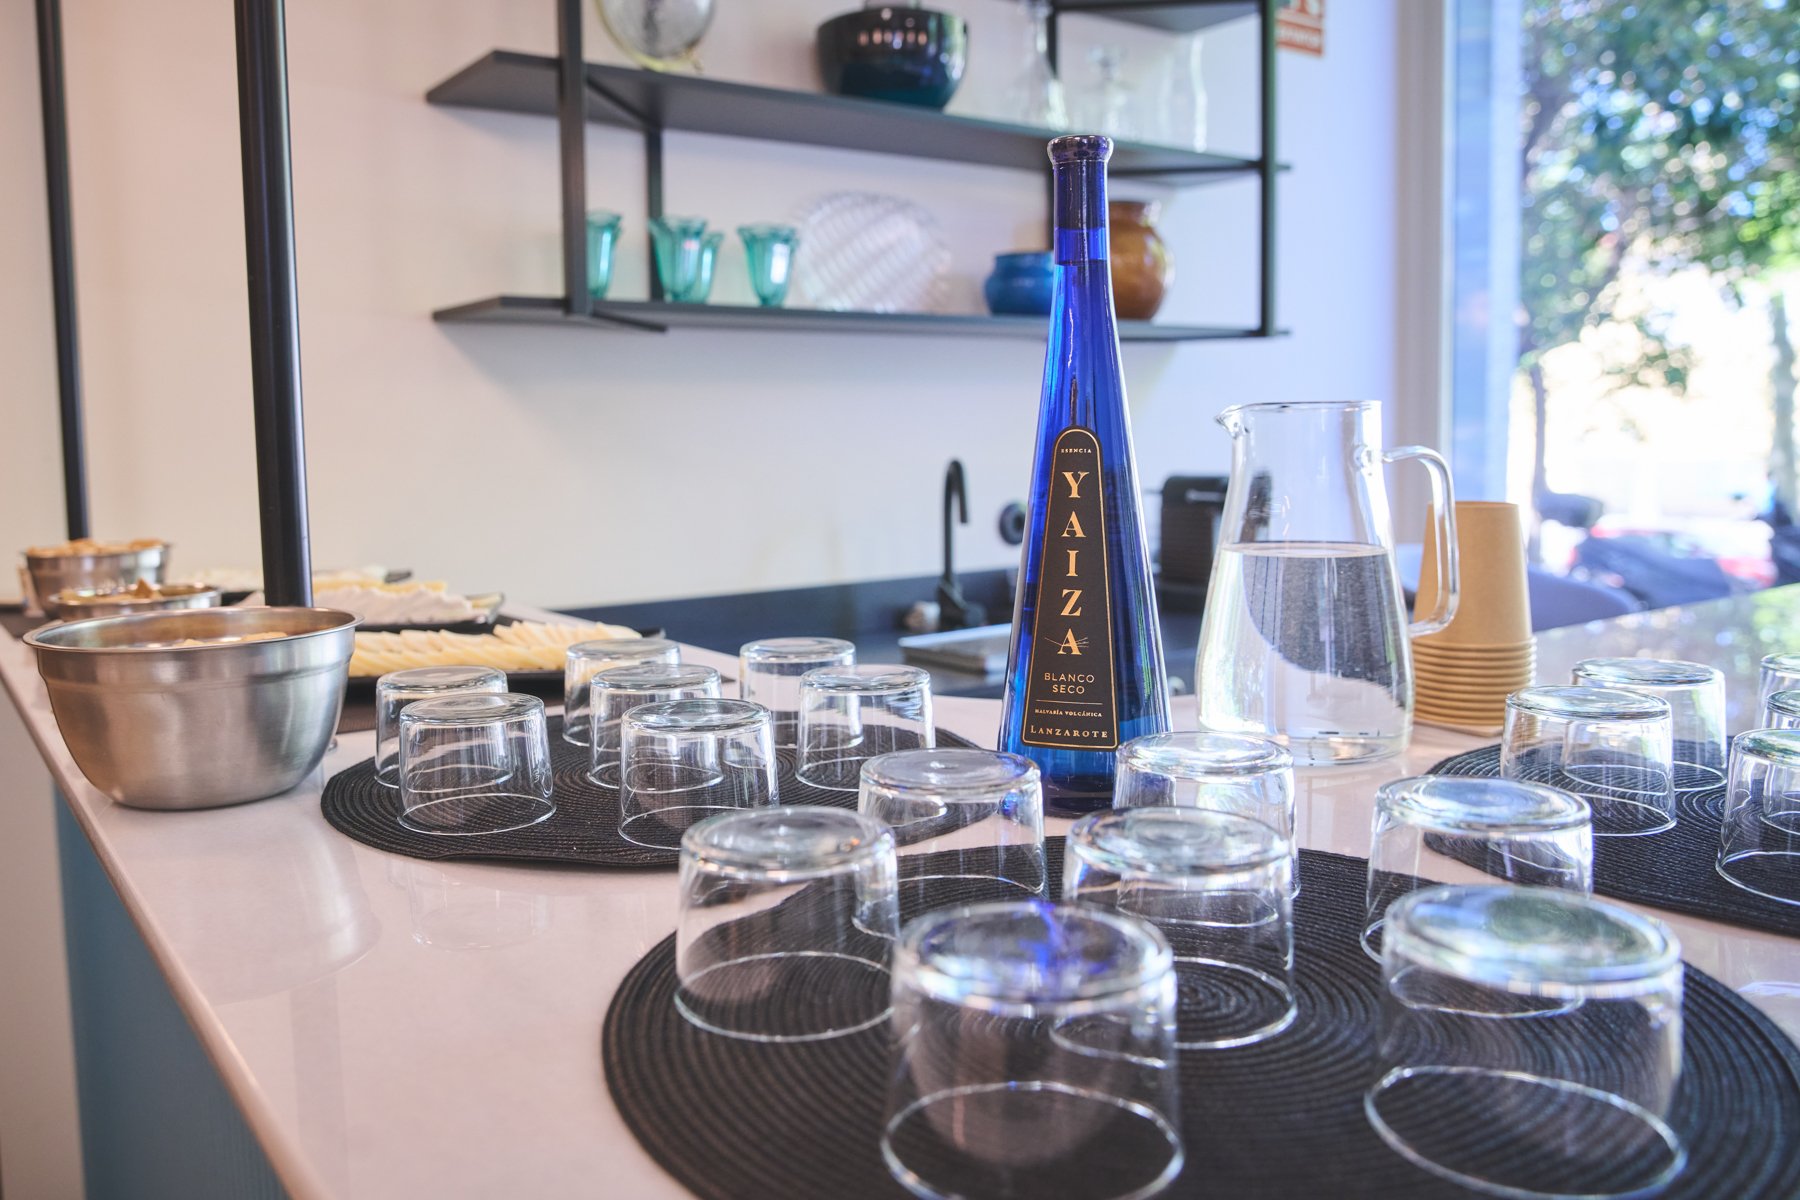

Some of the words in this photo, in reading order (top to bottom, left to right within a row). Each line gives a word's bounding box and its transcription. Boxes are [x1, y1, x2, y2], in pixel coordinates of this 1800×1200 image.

[1057, 471, 1090, 656] YAIZA
[1044, 672, 1095, 683] BLANCO
[1052, 684, 1085, 694] SECO
[1030, 725, 1108, 738] LANZAROTE
